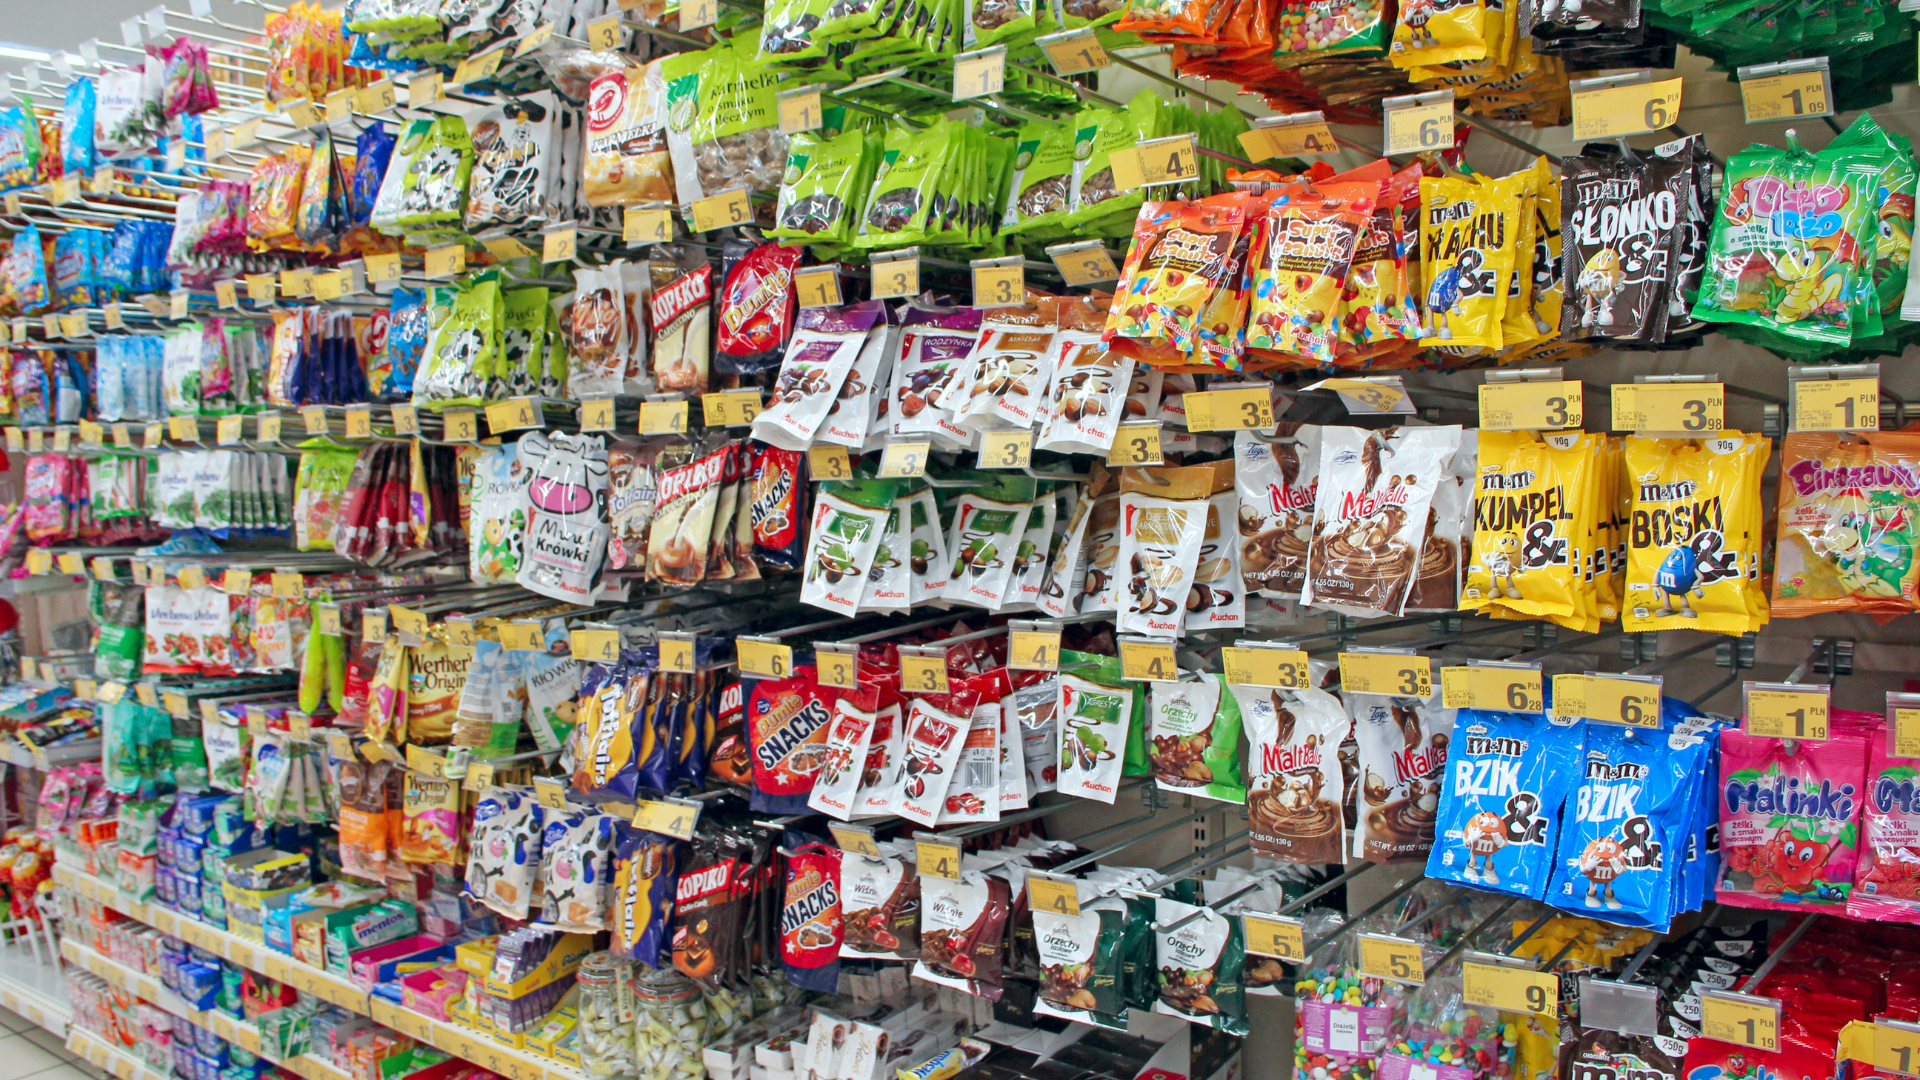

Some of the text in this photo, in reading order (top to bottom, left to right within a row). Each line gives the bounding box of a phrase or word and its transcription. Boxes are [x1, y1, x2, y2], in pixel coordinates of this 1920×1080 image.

[696, 6, 707, 24] 4
[604, 29, 614, 48] 3
[1080, 49, 1094, 67] 1
[978, 69, 989, 92] 1
[1806, 84, 1822, 94] PLN
[1782, 89, 1825, 115] 1 09
[1645, 98, 1667, 130] 6
[1304, 134, 1322, 152] 4
[1419, 119, 1439, 147] 6
[1166, 152, 1184, 177] 4
[728, 202, 740, 222] 5
[1571, 190, 1677, 245] SŁONKO
[654, 221, 664, 240] 4
[1166, 228, 1218, 249] Super
[558, 240, 568, 258] 2
[1149, 238, 1219, 264] Peanuts
[1084, 261, 1100, 280] 3
[815, 283, 825, 302] 1
[893, 273, 907, 295] 3
[997, 281, 1011, 304] 3
[652, 274, 706, 328] KOPIKO
[722, 268, 791, 336] Dumle
[924, 338, 973, 348] RODZYNKA
[1290, 326, 1328, 345] Auchan
[1200, 338, 1234, 356] Auchan
[1357, 387, 1383, 407] 3
[1708, 398, 1722, 406] PLN
[1860, 394, 1876, 402] PLN
[518, 408, 528, 425] 4
[998, 398, 1028, 418] Auchan
[1242, 402, 1272, 428] 3 99
[1546, 397, 1568, 426] 3
[1682, 400, 1722, 430] 3 98
[1835, 397, 1876, 428] 1 09
[596, 410, 606, 428] 4
[670, 412, 681, 432] 4
[936, 418, 967, 438] Auchan
[459, 422, 468, 439] 3
[829, 426, 860, 440] Auchan
[1132, 438, 1150, 463] 3
[1554, 436, 1569, 447] 90g
[1718, 440, 1733, 452] 90g
[901, 454, 916, 475] 3
[1002, 443, 1018, 466] 3
[829, 457, 842, 478] 3
[751, 470, 792, 529] SNACKS
[1474, 485, 1573, 532] KUMPEL
[981, 513, 1009, 523] AGREST
[1632, 496, 1725, 549] BOSKI
[536, 537, 590, 562] Krówki
[559, 582, 588, 594] Auchan
[874, 590, 905, 598] Auchan
[825, 592, 854, 608] Auchan
[1210, 612, 1238, 622] Auchan
[462, 630, 470, 646] 3
[602, 640, 612, 660] 4
[1031, 646, 1046, 667] 4
[674, 651, 685, 670] 4
[771, 655, 783, 675] 6
[1147, 656, 1163, 679] 4
[426, 672, 466, 692] Origin
[833, 665, 845, 686] 3
[922, 670, 936, 691] 3
[1278, 663, 1298, 687] 3
[1398, 669, 1418, 695] 3
[1528, 682, 1540, 690] PLN
[1507, 683, 1542, 710] 6 28
[1644, 696, 1658, 705] PLN
[757, 695, 802, 738] Dumle
[1160, 704, 1198, 722] Orzechy
[1620, 696, 1656, 726] 6 28
[1810, 707, 1825, 716] PLN
[1786, 708, 1825, 738] 1 19
[757, 699, 831, 771] SNACKS
[1466, 736, 1529, 757] m&m's
[1259, 742, 1322, 778] MaltBalls
[1454, 759, 1523, 798] BZIK
[1586, 761, 1649, 781] m&m's
[1082, 780, 1112, 793] Auchan
[819, 794, 846, 810] Auchan
[1575, 783, 1642, 824] BZIK
[1724, 773, 1855, 822] Malinki
[902, 800, 932, 818] Auchan
[668, 816, 684, 836] 4
[1732, 820, 1752, 829] żelki
[1738, 828, 1764, 836] smaku
[1370, 839, 1381, 847] NET
[1725, 836, 1762, 844] owocowym
[936, 857, 949, 878] 4
[677, 864, 728, 900] KOPIKO
[782, 880, 838, 935] SNACKS
[1053, 895, 1068, 916] 4
[358, 912, 404, 940] mentos
[1044, 934, 1080, 952] Orzechy
[1167, 936, 1206, 956] Orzechy
[1274, 935, 1292, 959] 5
[1724, 942, 1744, 952] 250g
[1390, 955, 1408, 980] 5
[1706, 972, 1727, 987] 250g
[1526, 985, 1556, 1017] 9 76
[1333, 1022, 1356, 1030] Drażetki
[1738, 1018, 1774, 1048] 1 19
[1662, 1038, 1684, 1054] 250g
[1890, 1046, 1911, 1072] 1
